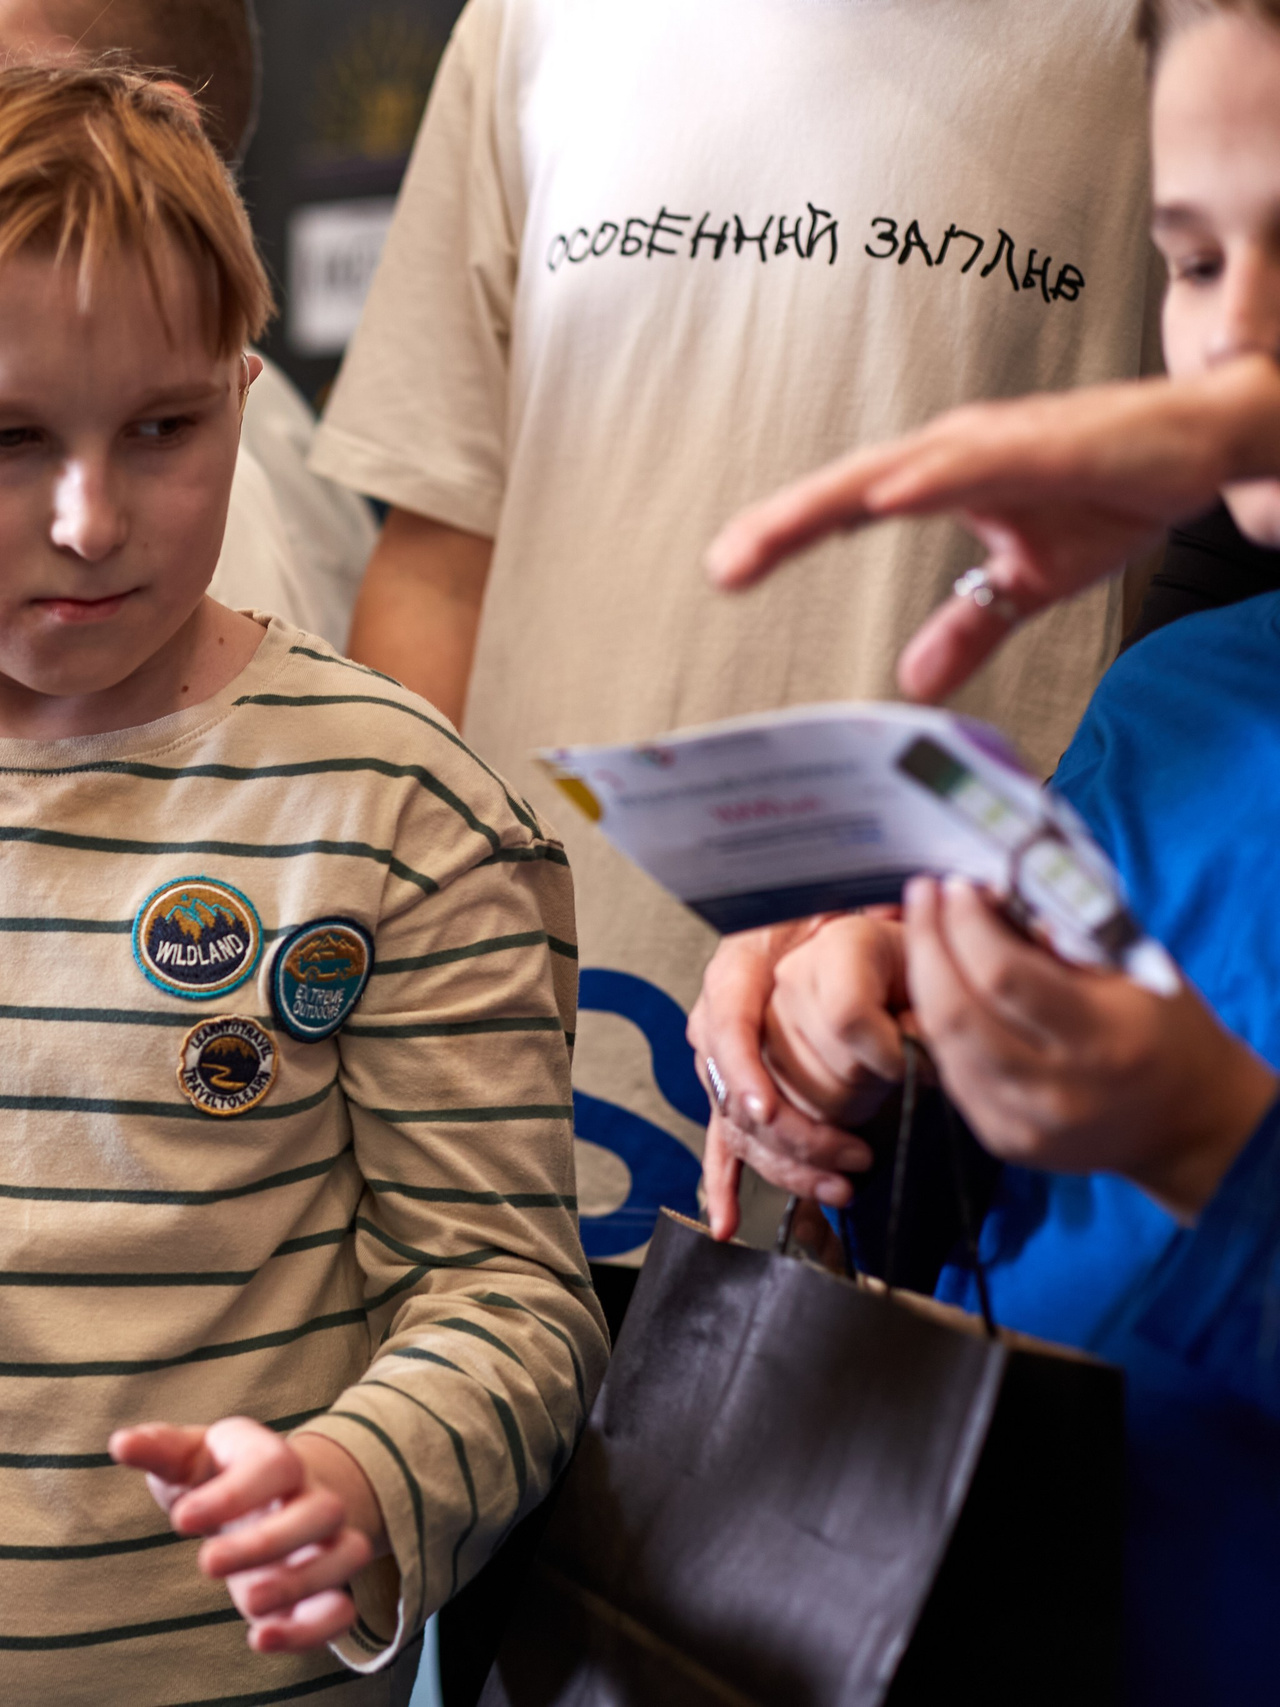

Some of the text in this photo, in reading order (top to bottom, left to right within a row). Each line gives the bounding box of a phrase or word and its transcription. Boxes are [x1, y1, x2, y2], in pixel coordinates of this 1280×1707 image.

[547, 202, 1086, 302] ОСОБЕННЫЙ ЗАПЛЫВ
[155, 933, 244, 966] WILDLAND
[293, 1000, 340, 1019] OUTDOORS
[295, 983, 345, 1005] EXTREME
[190, 1021, 223, 1049] LEARN
[239, 1022, 274, 1061] TRAVEL
[183, 1067, 272, 1109] TRAVEL TO LEARN
